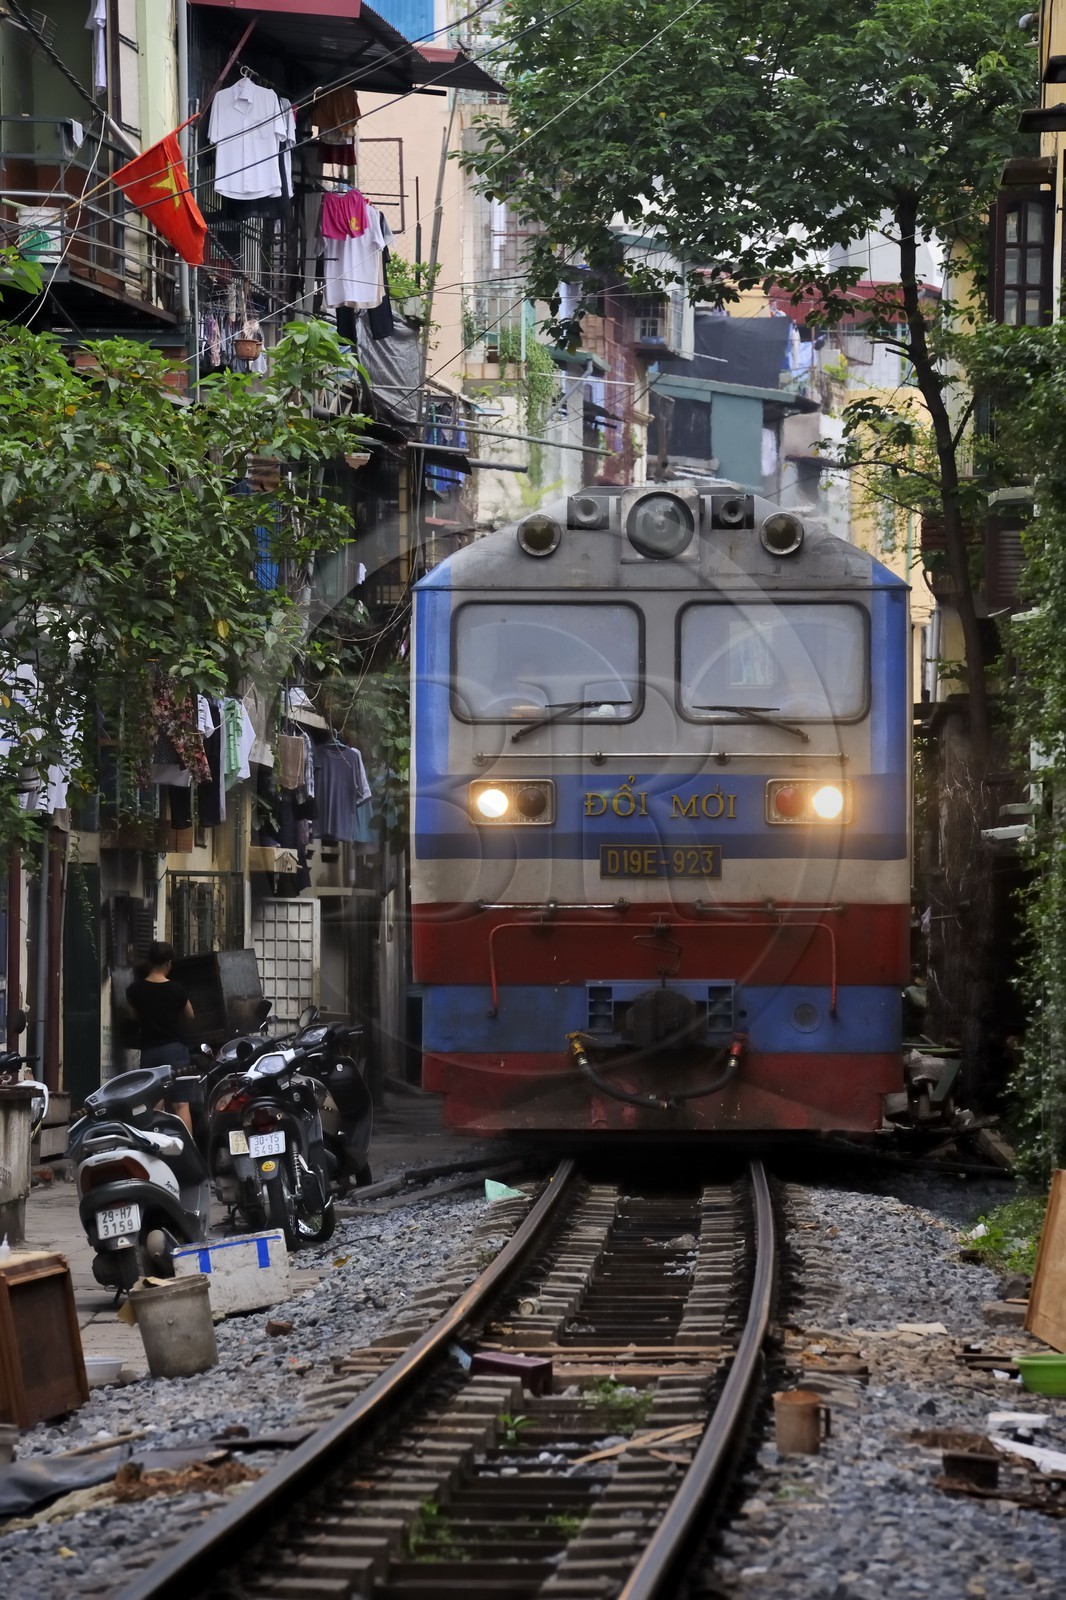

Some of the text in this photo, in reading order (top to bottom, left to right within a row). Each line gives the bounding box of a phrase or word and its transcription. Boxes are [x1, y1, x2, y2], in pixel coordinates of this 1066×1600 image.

[584, 775, 737, 819] ĐỔI MỚI
[607, 849, 714, 875] D19E-923
[254, 1143, 280, 1156] 5493
[101, 1206, 132, 1224] 29-H7
[103, 1219, 133, 1237] 3159
